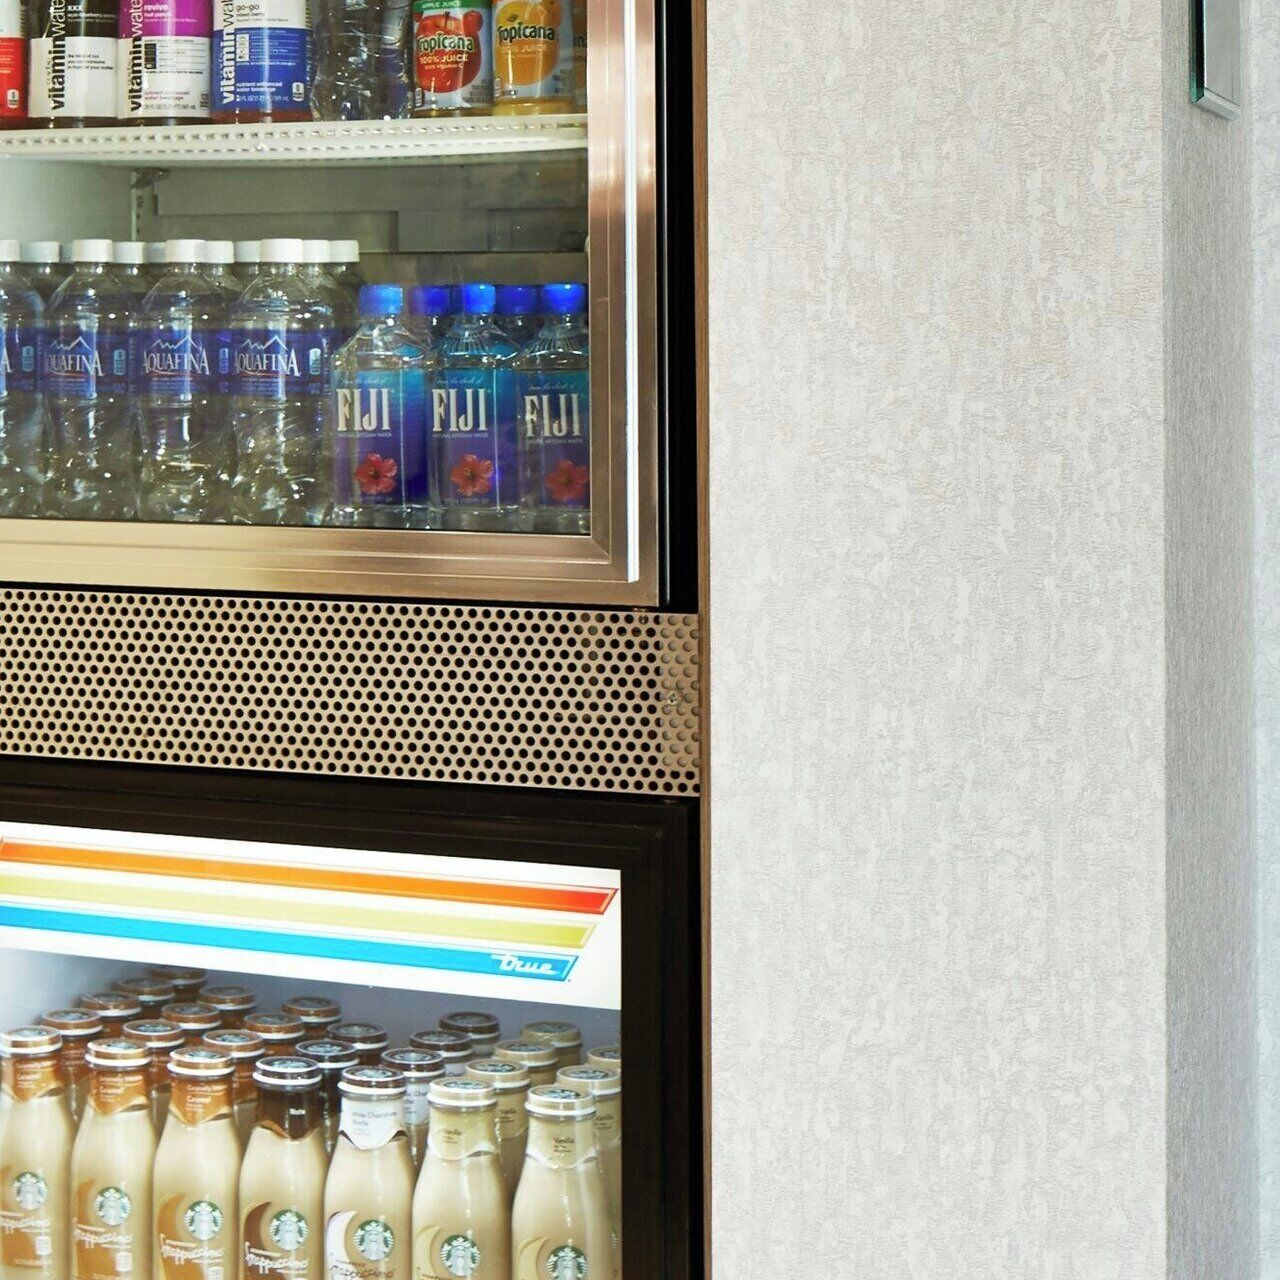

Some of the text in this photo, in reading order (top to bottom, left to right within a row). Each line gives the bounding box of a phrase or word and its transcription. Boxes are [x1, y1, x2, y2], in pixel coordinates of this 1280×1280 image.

[418, 31, 474, 52] Tropicana
[497, 21, 556, 43] Tropicana
[336, 388, 391, 432] FIJI
[432, 388, 489, 432] FIJI
[524, 393, 582, 438] FIJI
